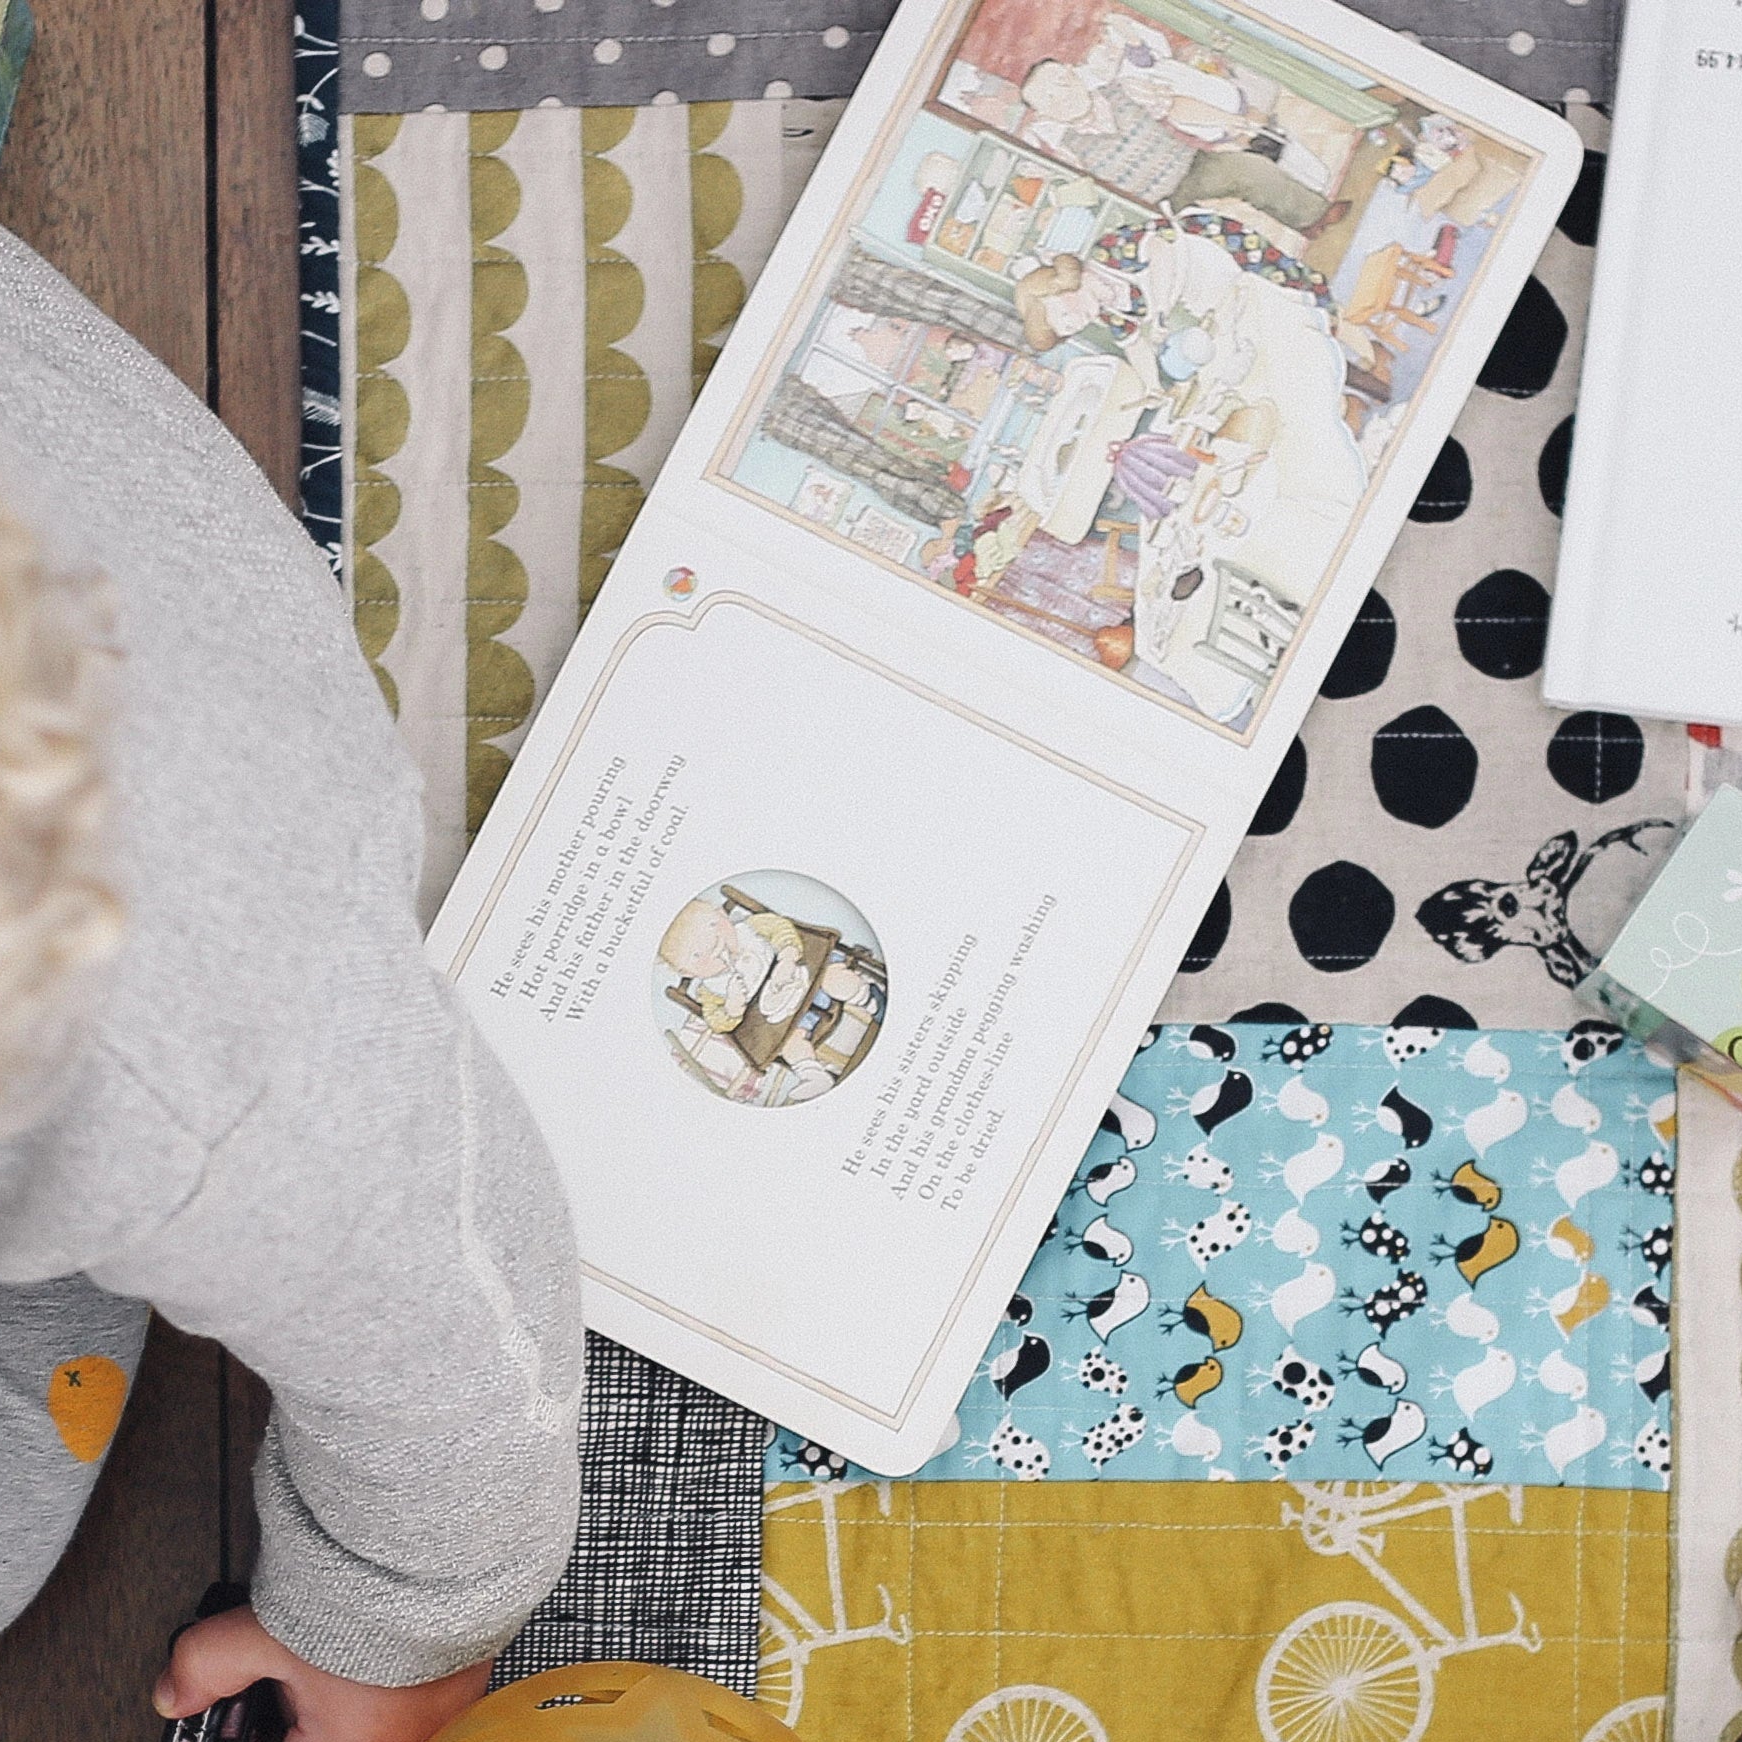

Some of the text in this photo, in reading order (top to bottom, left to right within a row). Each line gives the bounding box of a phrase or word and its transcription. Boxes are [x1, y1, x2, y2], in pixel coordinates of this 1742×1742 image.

[489, 755, 627, 998] He sees his mother pouring
[518, 795, 634, 999] Hot porridge in a bowl
[539, 754, 686, 1023] And his father in the doorway
[564, 805, 690, 1020] With a bucketful of coal.
[840, 933, 978, 1176] He sees his sisters skipping
[869, 1007, 968, 1178] In the yard outside
[890, 893, 1058, 1201] And his grandma pegging washing
[917, 1031, 1014, 1201] On the clothes-line
[939, 1104, 1007, 1211] To be dried.
